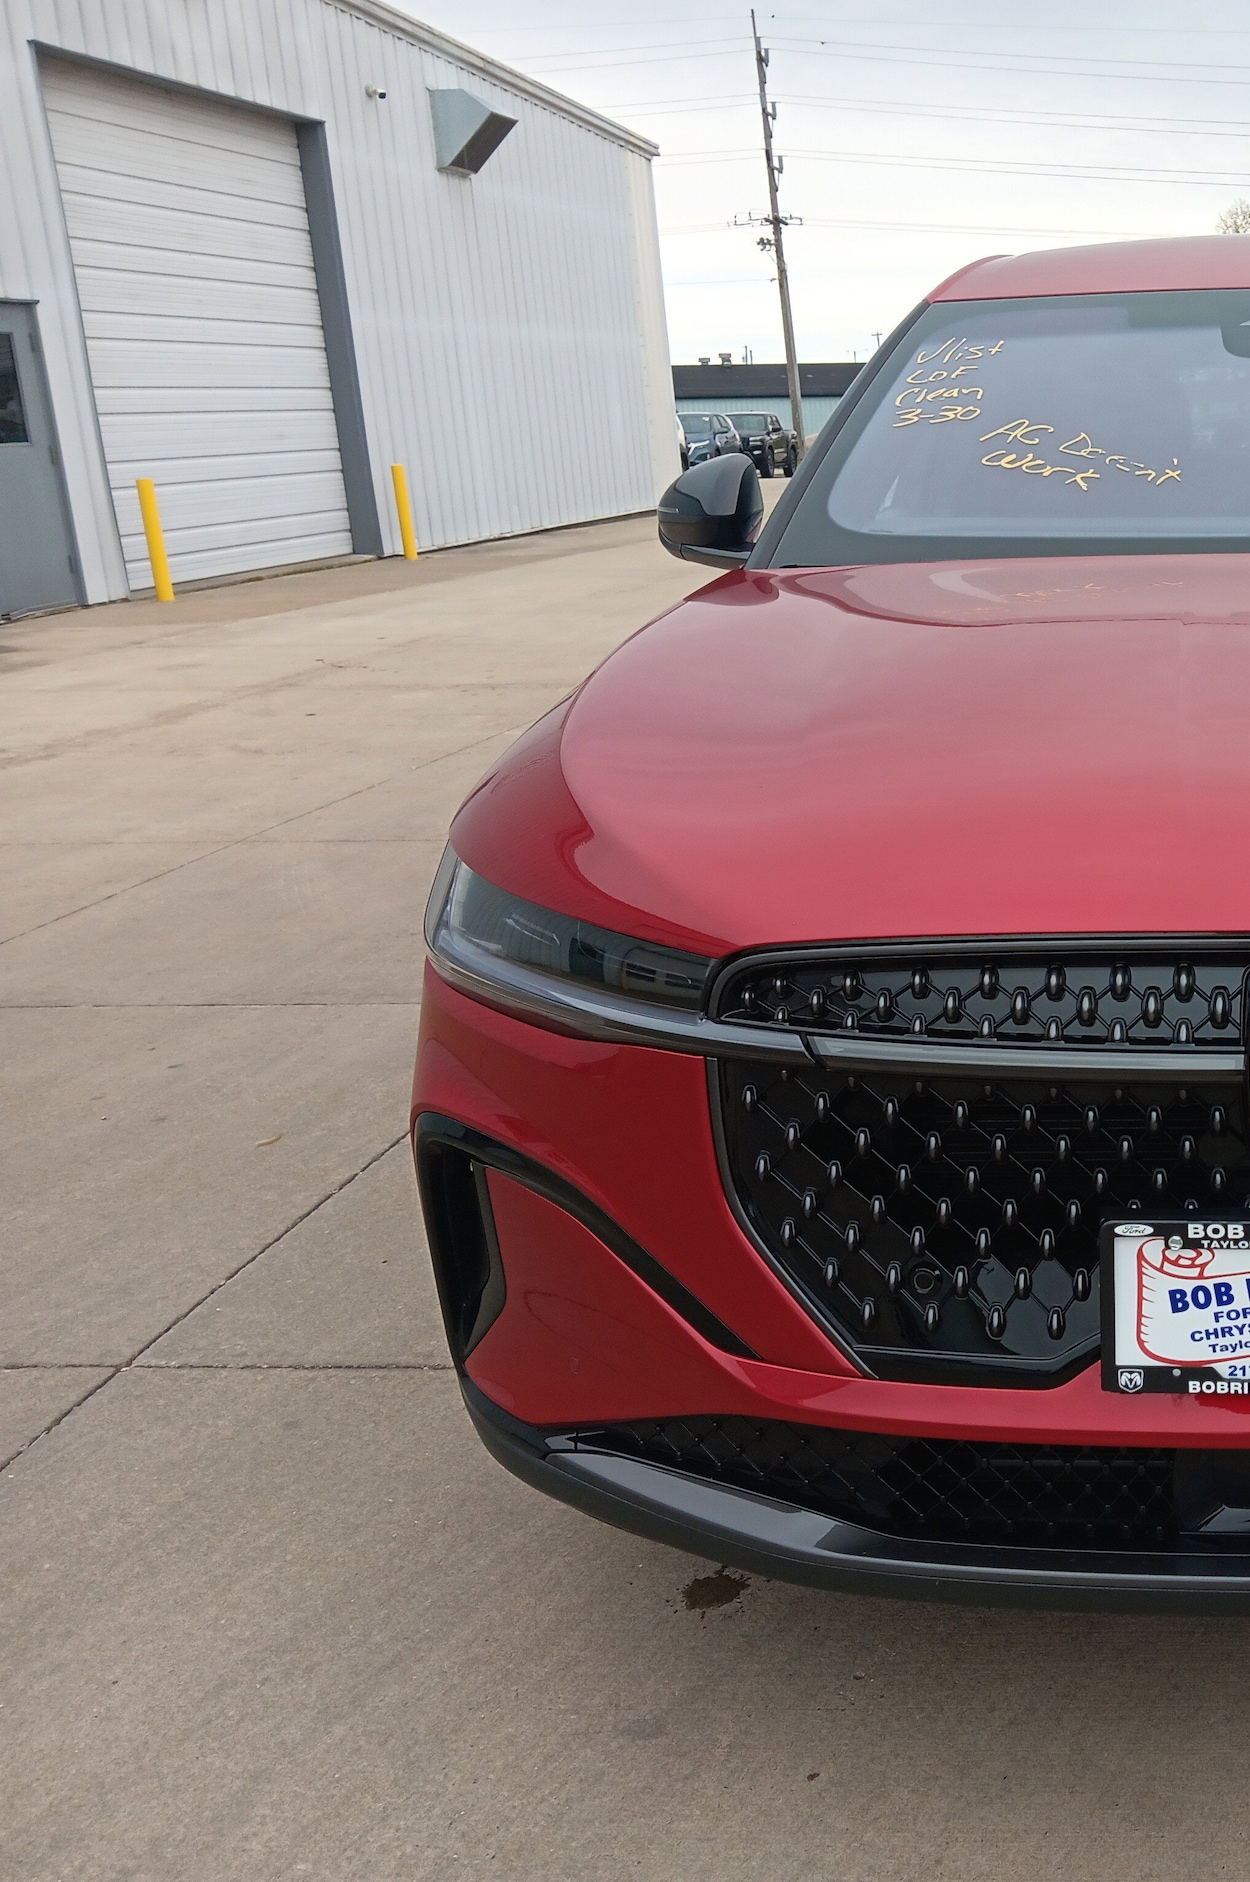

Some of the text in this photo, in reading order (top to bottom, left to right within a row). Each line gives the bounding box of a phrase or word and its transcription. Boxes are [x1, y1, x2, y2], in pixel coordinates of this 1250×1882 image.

[893, 405, 981, 428] 3-30
[979, 419, 1055, 445] AC
[1188, 1223, 1245, 1239] BOB
[1168, 1282, 1235, 1314] BOB
